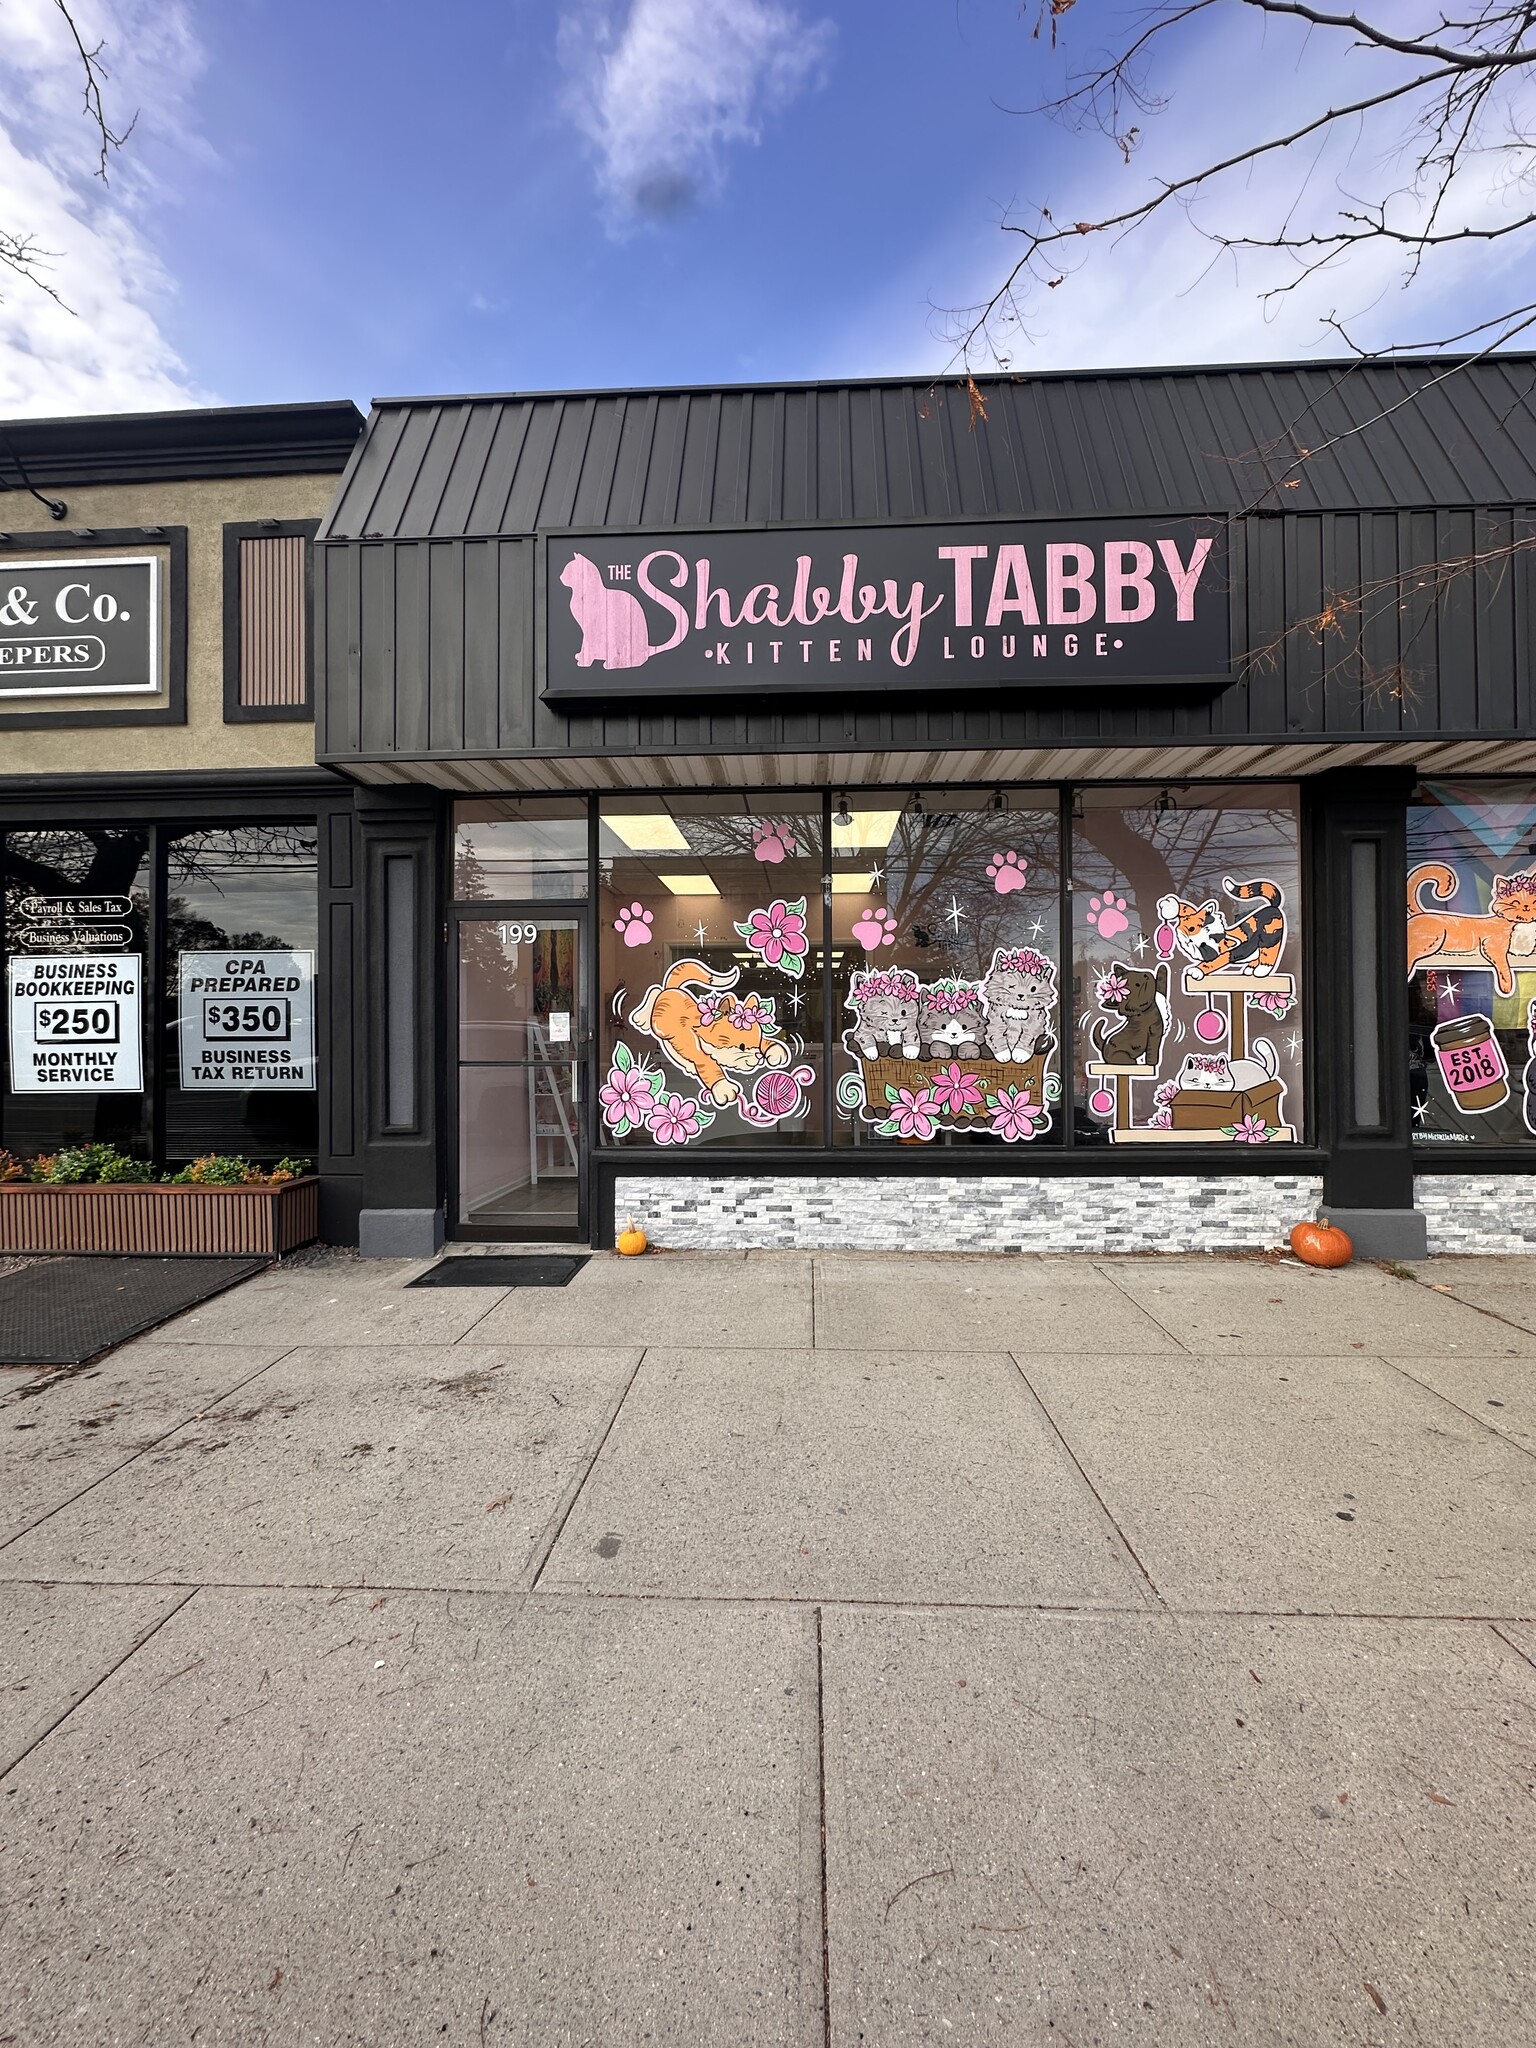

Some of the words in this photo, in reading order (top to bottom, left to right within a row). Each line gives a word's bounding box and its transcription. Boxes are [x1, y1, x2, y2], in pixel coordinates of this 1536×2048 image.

[0, 586, 39, 626] &
[55, 583, 131, 624] Co.
[607, 564, 632, 581] THE
[637, 550, 945, 667] Shabby
[938, 538, 1214, 627] TABBY
[30, 901, 63, 915] Payroll
[65, 901, 76, 913] &
[78, 901, 102, 913] Sales
[104, 900, 122, 913] Tax
[28, 931, 70, 943] Business
[72, 930, 124, 942] Valuations
[498, 924, 537, 944] 199
[34, 963, 118, 979] BUSINESS
[225, 959, 266, 975] CPA
[15, 980, 135, 997] BOOKKEEPING
[190, 977, 301, 993] PREPARED
[39, 1008, 111, 1035] $250
[208, 1005, 281, 1032] $350
[33, 1052, 118, 1066] MONTHLY
[201, 1050, 292, 1064] BUSINESS
[1450, 1047, 1489, 1067] EST.
[37, 1068, 115, 1082] SERVICE
[191, 1066, 225, 1080] TAX
[231, 1066, 304, 1080] RETURN
[1450, 1059, 1496, 1086] 2018
